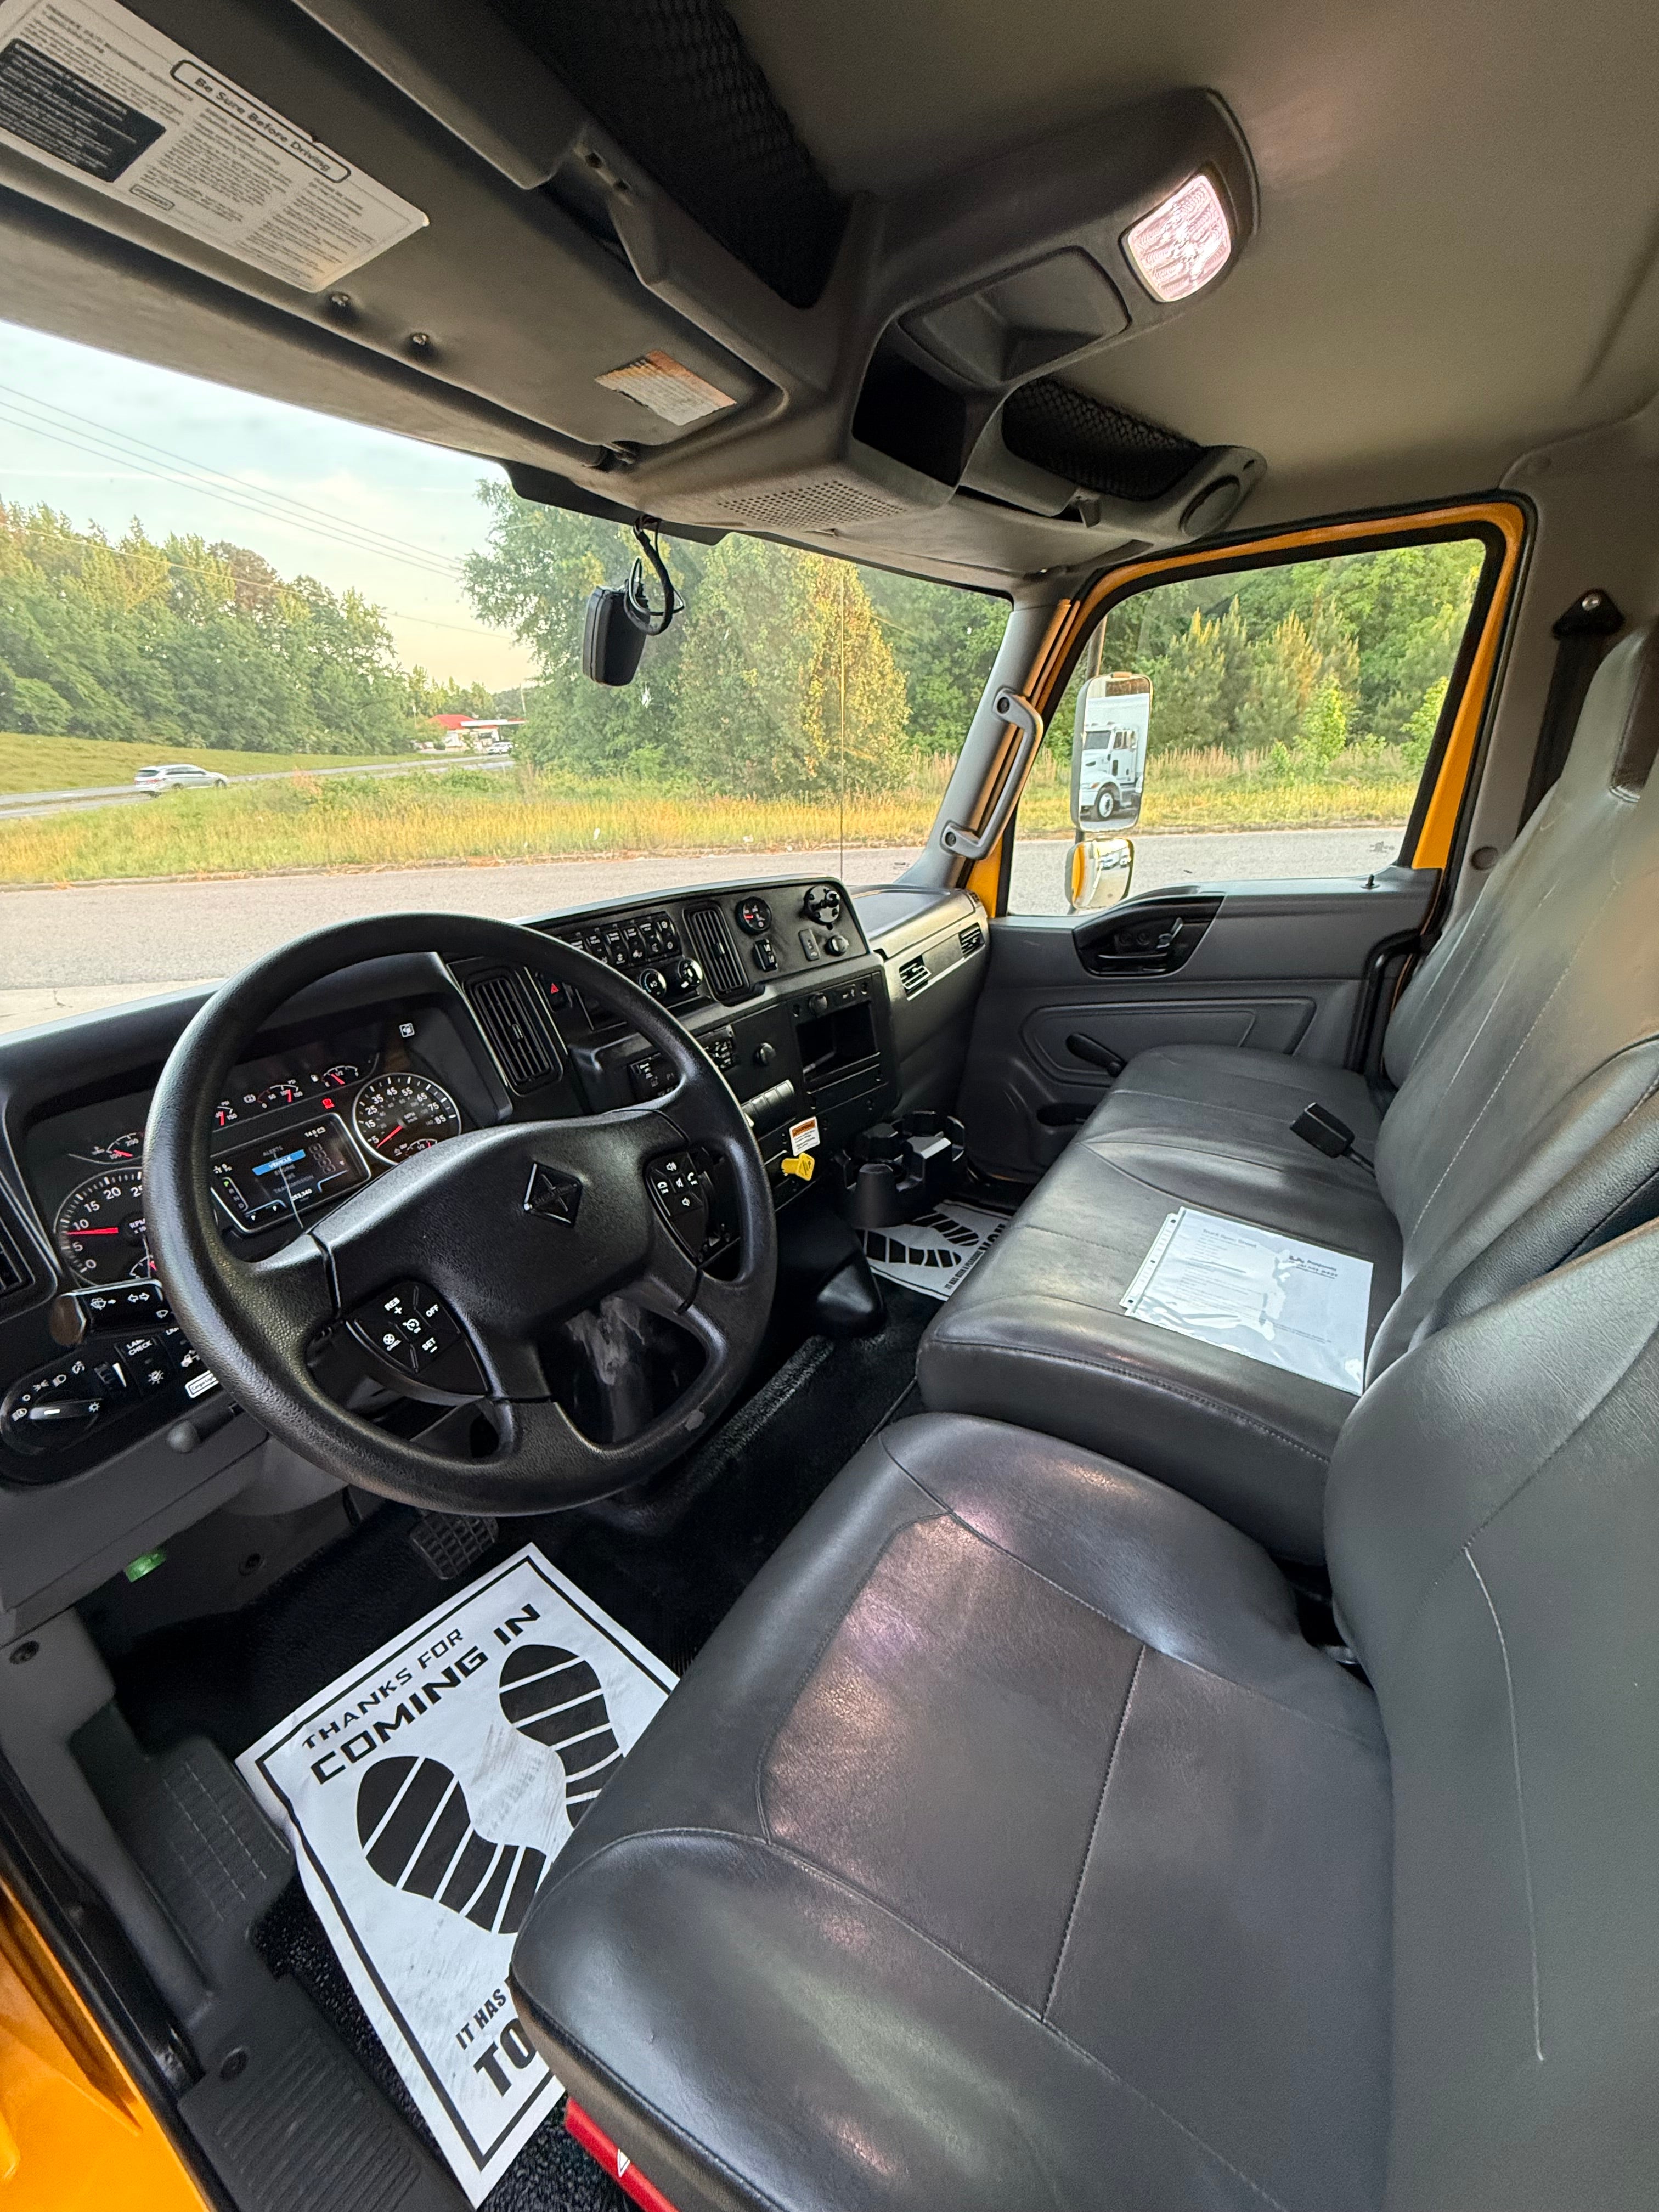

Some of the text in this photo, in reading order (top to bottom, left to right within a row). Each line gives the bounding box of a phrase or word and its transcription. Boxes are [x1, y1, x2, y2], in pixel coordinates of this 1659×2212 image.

[194, 77, 331, 171] Be Sure Before Driving
[387, 1087, 398, 1096] 45
[401, 1087, 413, 1096] 55
[417, 1092, 428, 1102] 65
[371, 1094, 384, 1104] 35
[365, 1105, 378, 1115] 25
[427, 1102, 439, 1111] 75
[365, 1119, 376, 1128] 15
[434, 1115, 447, 1124] 85
[125, 1138, 139, 1147] 200
[371, 1135, 380, 1144] 5
[269, 1156, 292, 1169] VEHICLE
[103, 1187, 121, 1200] 20
[83, 1200, 100, 1213] 15
[72, 1219, 89, 1231] 10
[72, 1242, 83, 1252] 5
[86, 1259, 97, 1269] 0
[384, 1297, 400, 1311] RES
[425, 1304, 439, 1317] OFF
[128, 1340, 153, 1356] CHECK
[422, 1337, 436, 1351] SET
[302, 1628, 464, 1750] THANKS FOR
[311, 1603, 541, 1785] COMING IN
[455, 1988, 506, 2050] IT HAS
[473, 2017, 537, 2097] TO
